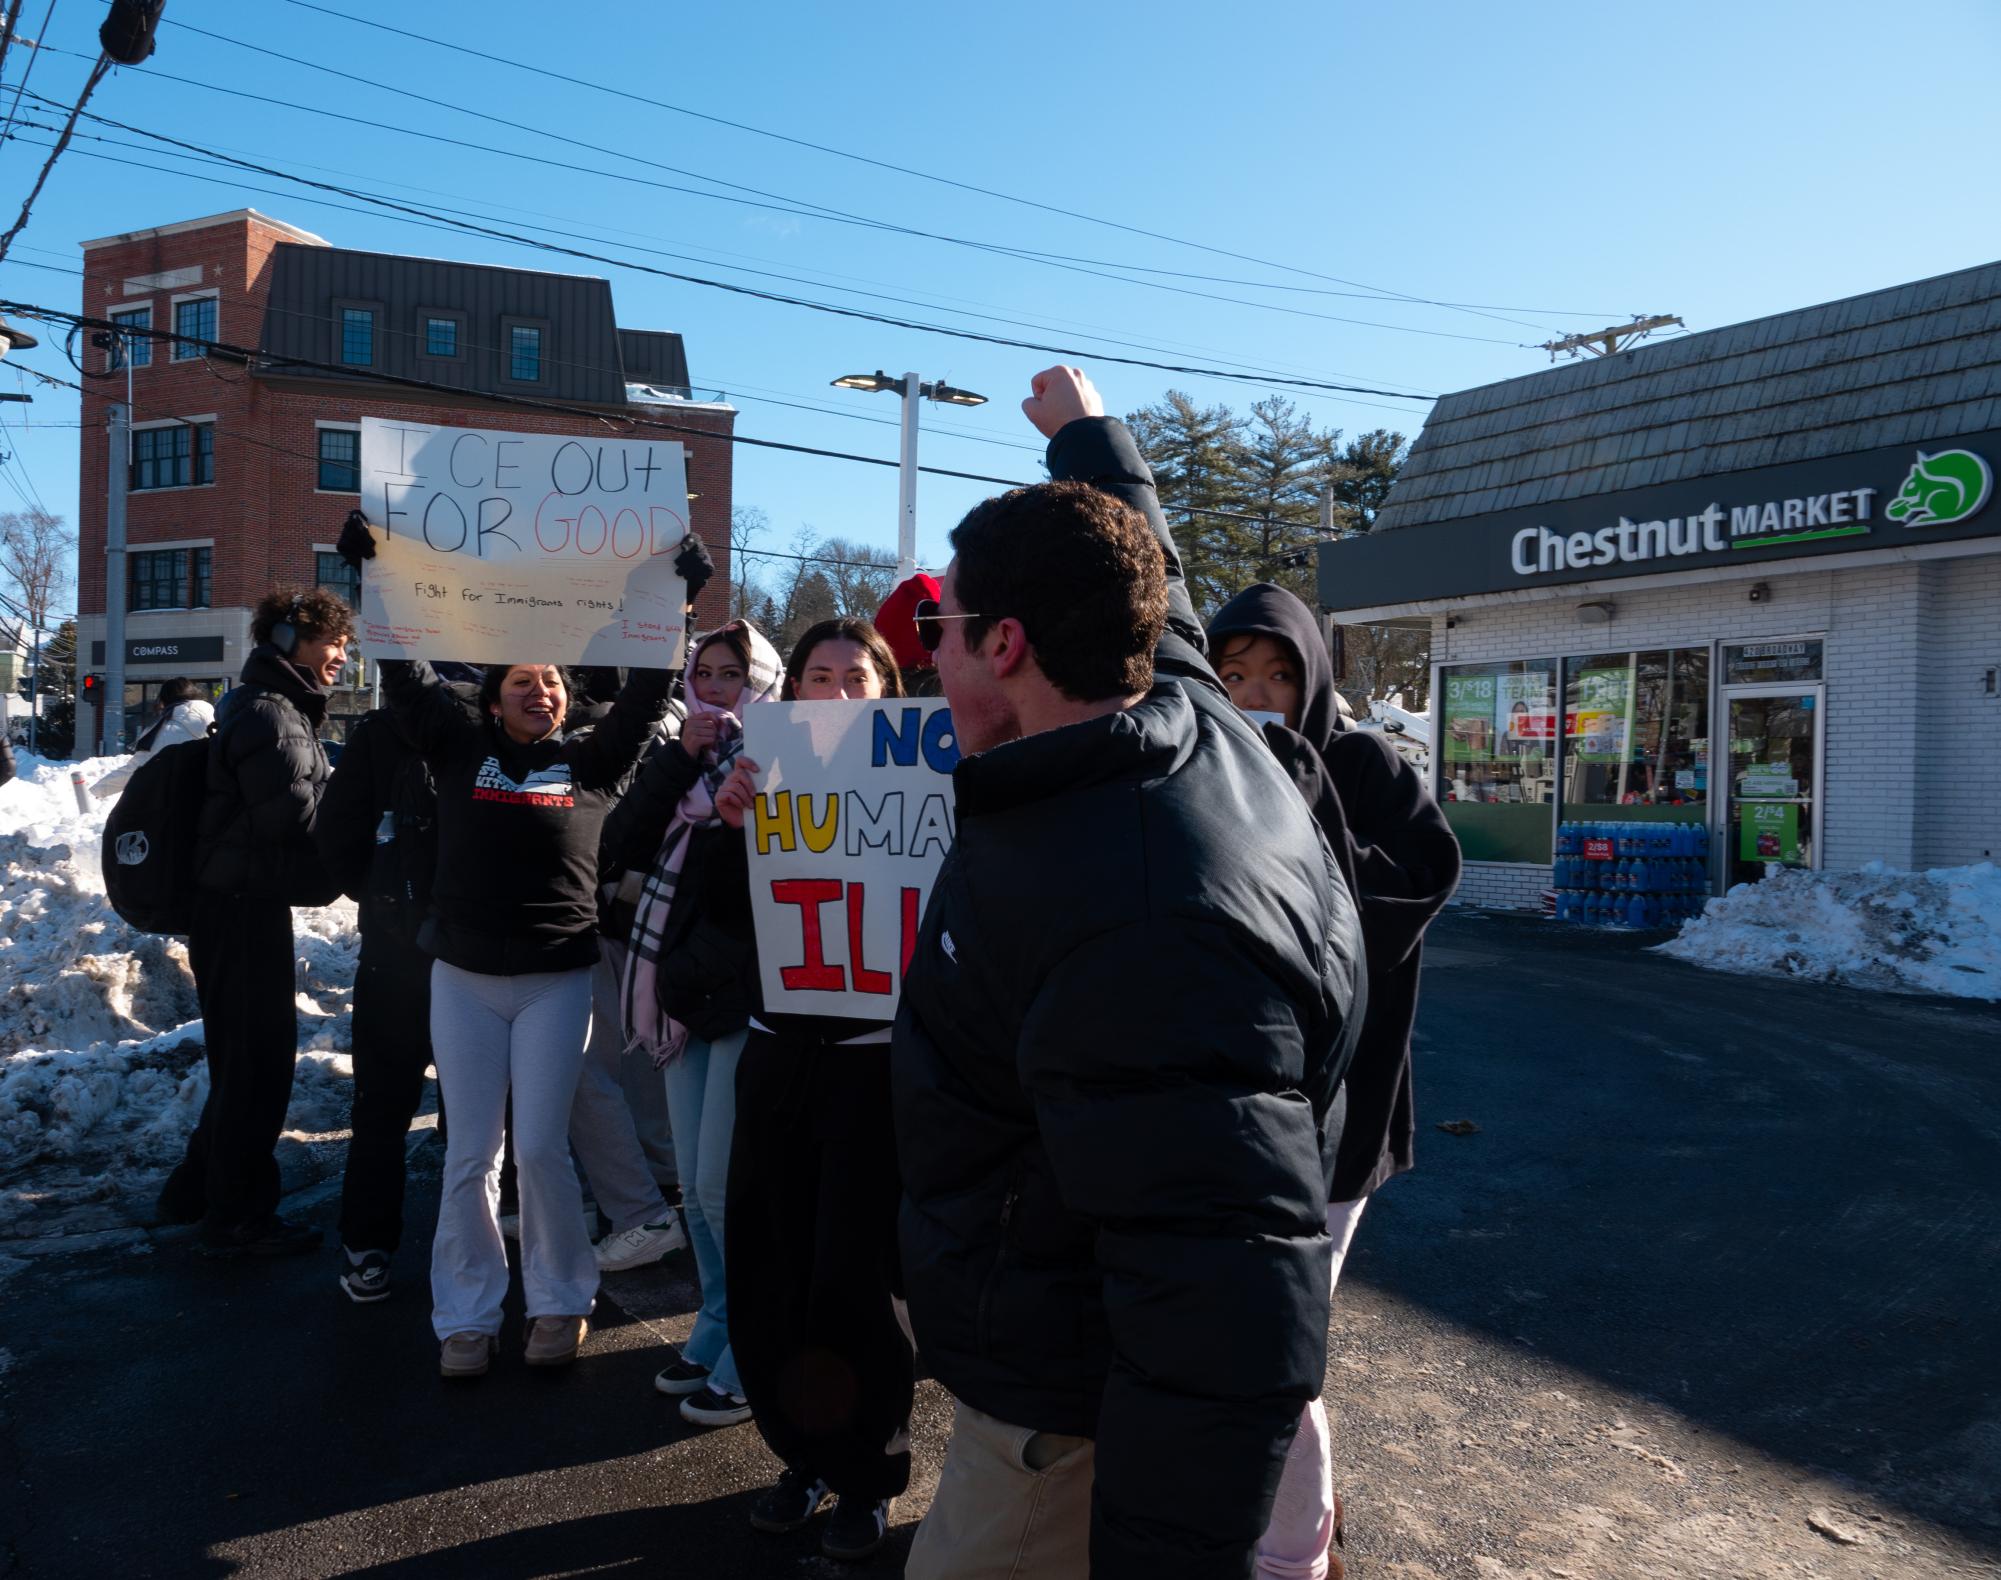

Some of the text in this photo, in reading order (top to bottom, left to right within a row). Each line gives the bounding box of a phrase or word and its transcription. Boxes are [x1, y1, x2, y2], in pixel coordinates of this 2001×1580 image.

[374, 425, 525, 489] ICE
[384, 482, 688, 559] FOR GOOD
[1511, 488, 1876, 576] Chestnut MARKET
[415, 582, 448, 599] Fight
[495, 593, 563, 608] Immigrants
[133, 645, 178, 657] COMPASS
[1449, 680, 1492, 701] 3/$18
[872, 707, 961, 775] NO
